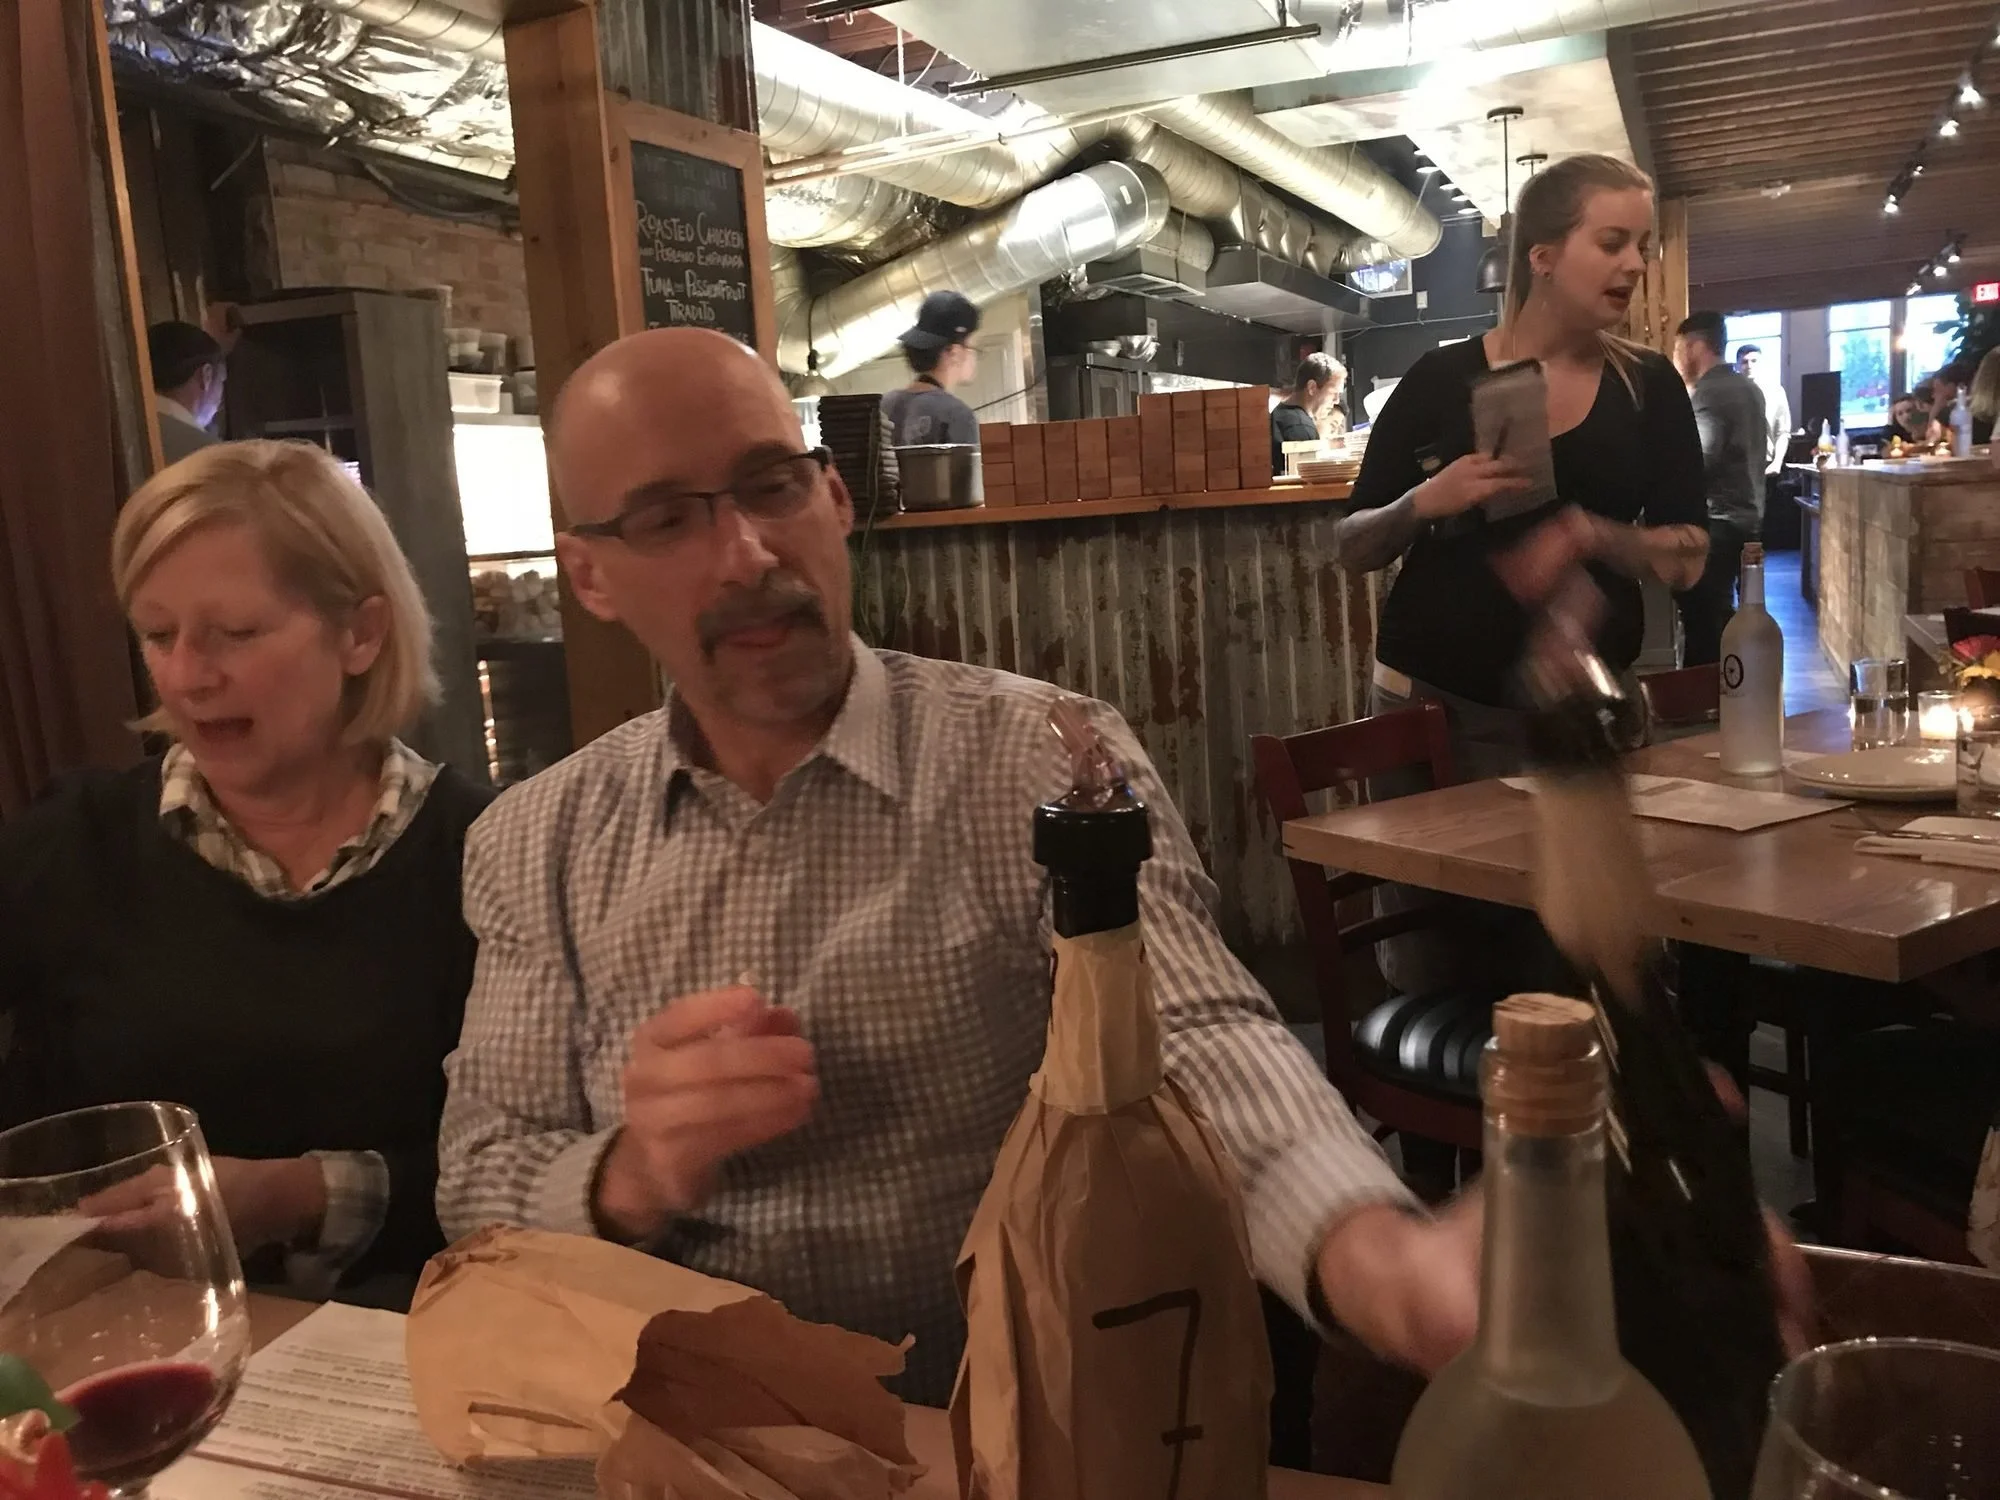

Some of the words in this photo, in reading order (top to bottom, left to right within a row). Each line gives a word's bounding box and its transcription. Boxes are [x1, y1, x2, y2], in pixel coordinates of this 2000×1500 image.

[635, 200, 695, 242] ROASTED
[697, 212, 744, 249] CHICKEN
[640, 267, 675, 297] TUNA
[1975, 283, 1999, 301] EXI
[1092, 1288, 1204, 1500] 7
